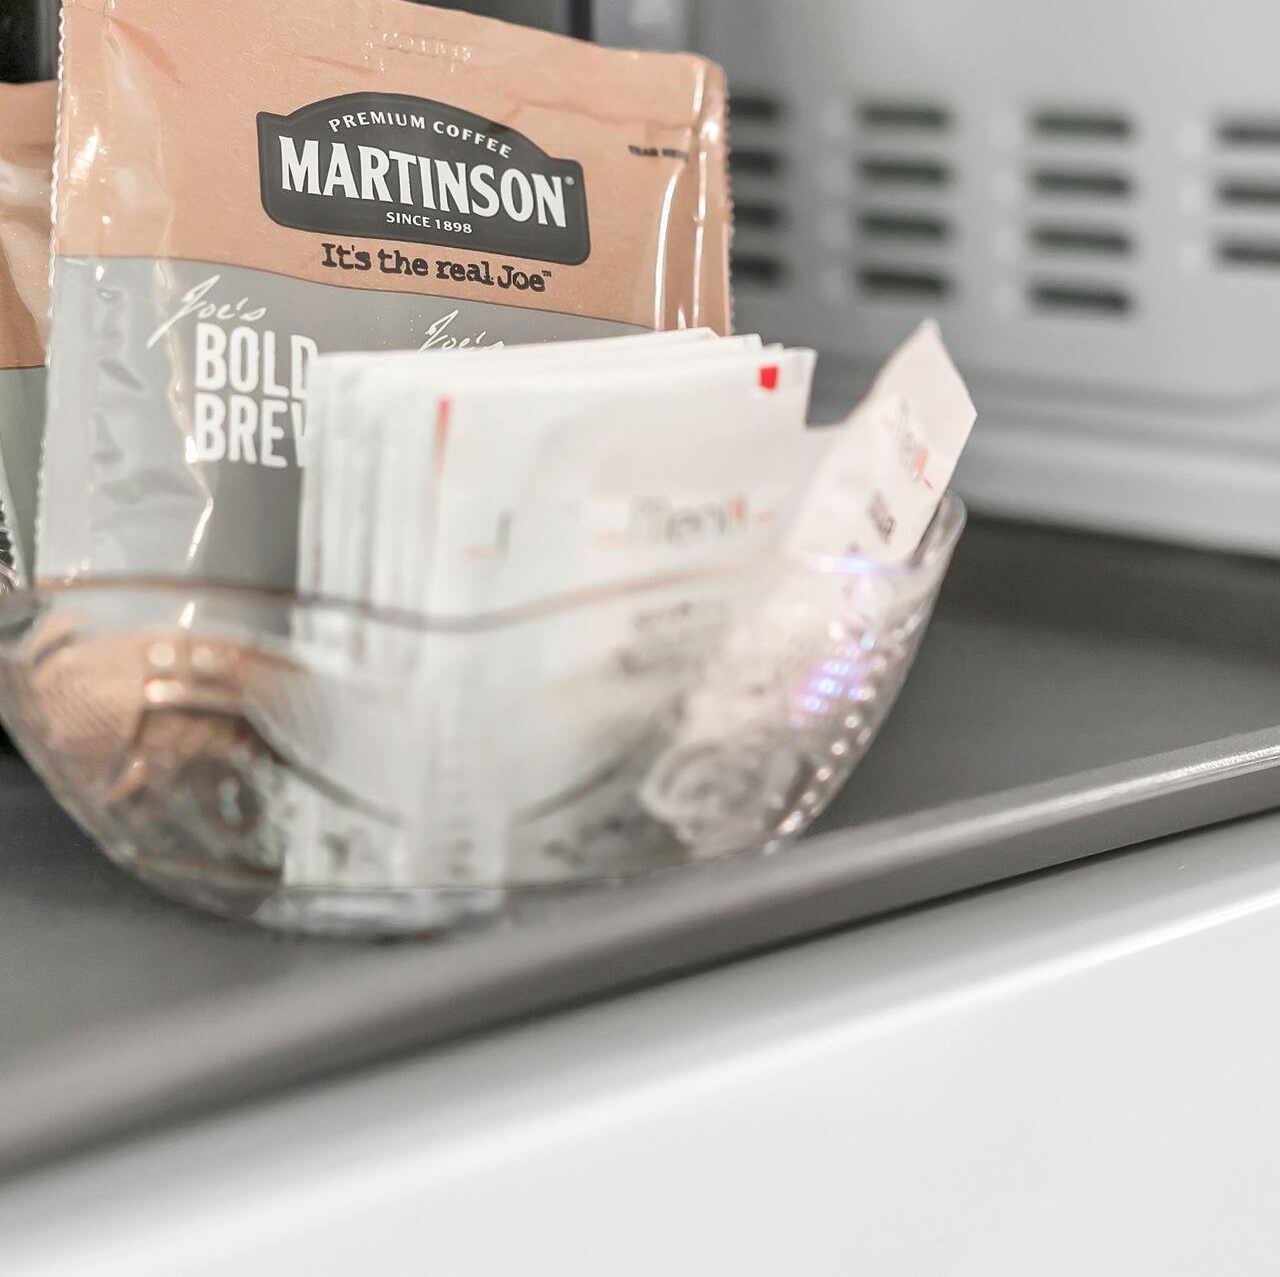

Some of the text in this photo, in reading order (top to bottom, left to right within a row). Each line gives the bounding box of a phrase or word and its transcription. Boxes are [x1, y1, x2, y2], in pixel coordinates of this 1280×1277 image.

[328, 110, 513, 159] PREMIUM COFFEE
[385, 211, 473, 234] SINCE 1898
[321, 242, 372, 271] It's
[377, 248, 429, 276] the
[436, 260, 494, 286] real
[145, 274, 267, 349] Joe's
[195, 321, 320, 401] BOLD
